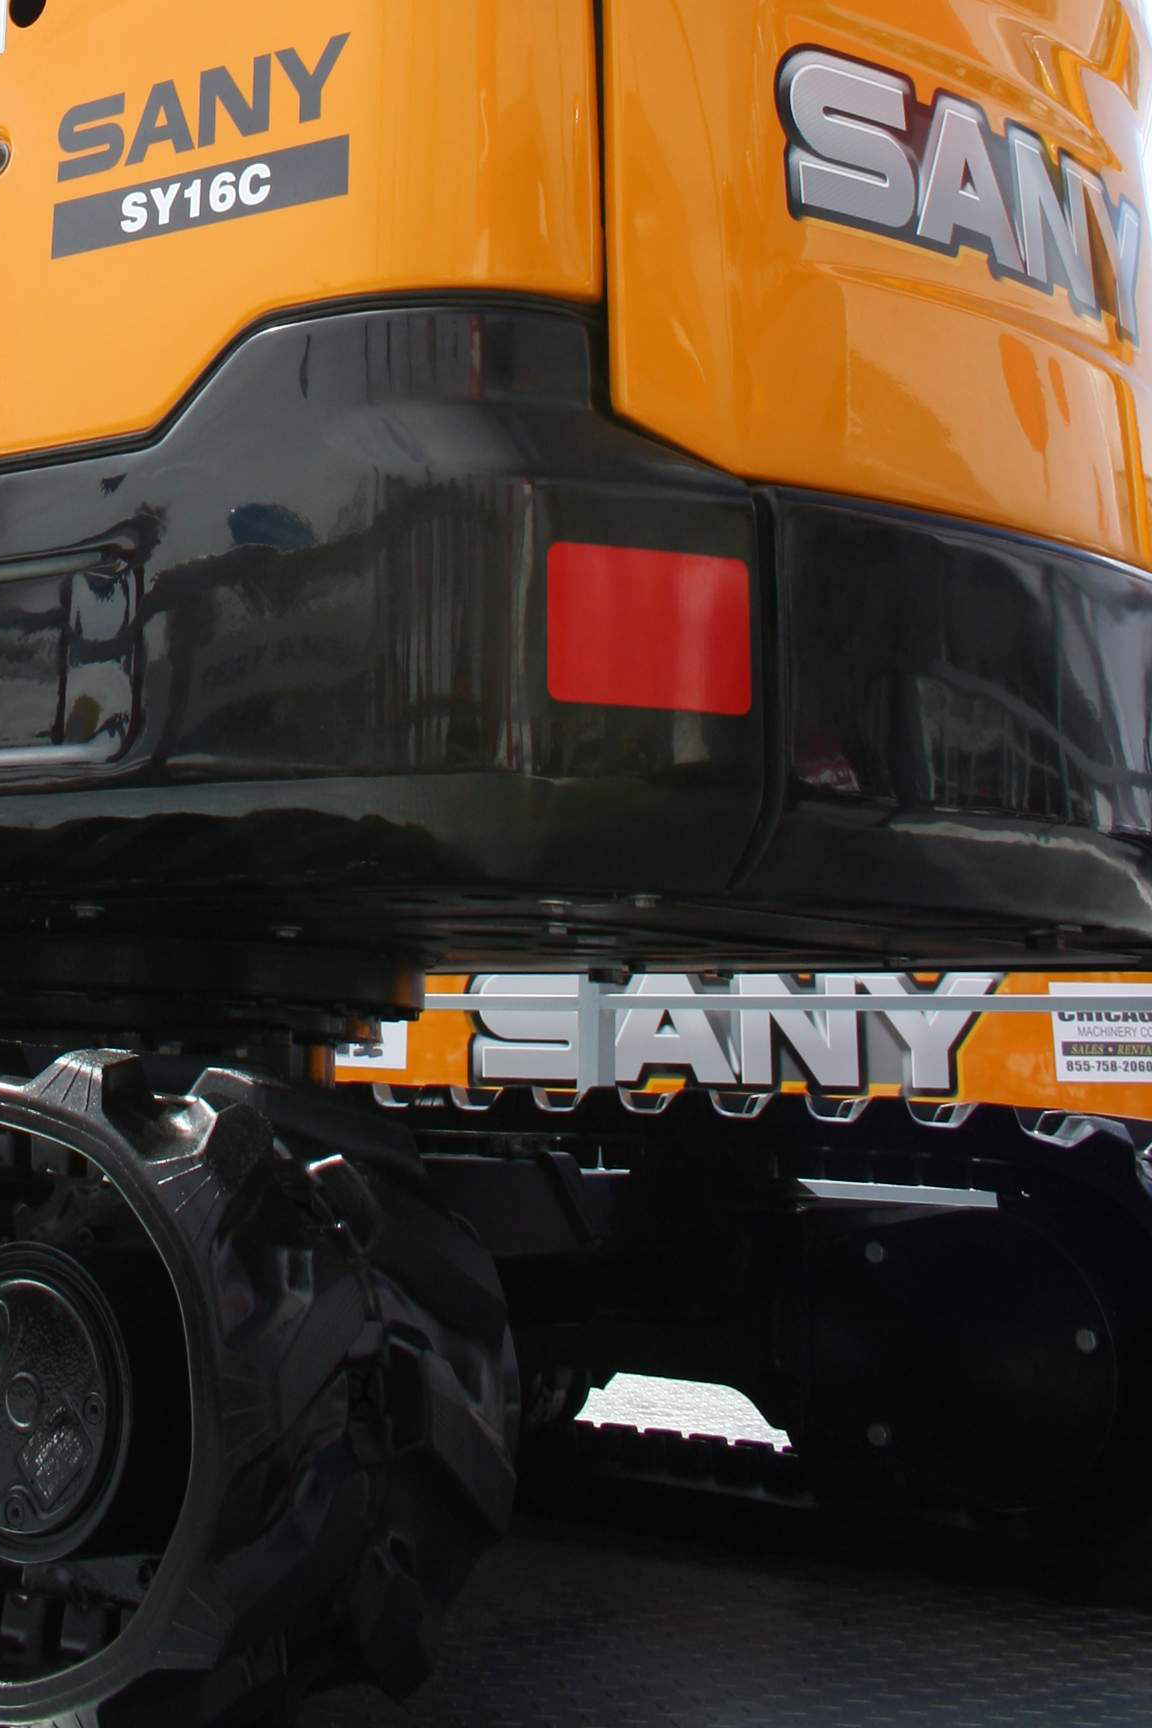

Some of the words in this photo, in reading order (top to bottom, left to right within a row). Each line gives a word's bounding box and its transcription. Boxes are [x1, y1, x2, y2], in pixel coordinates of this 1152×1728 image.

[56, 32, 352, 183] SANY
[120, 163, 272, 233] SY16C
[778, 45, 1141, 347] SANY
[1072, 1044, 1104, 1055] SALES
[1078, 1027, 1136, 1037] MACHINERY
